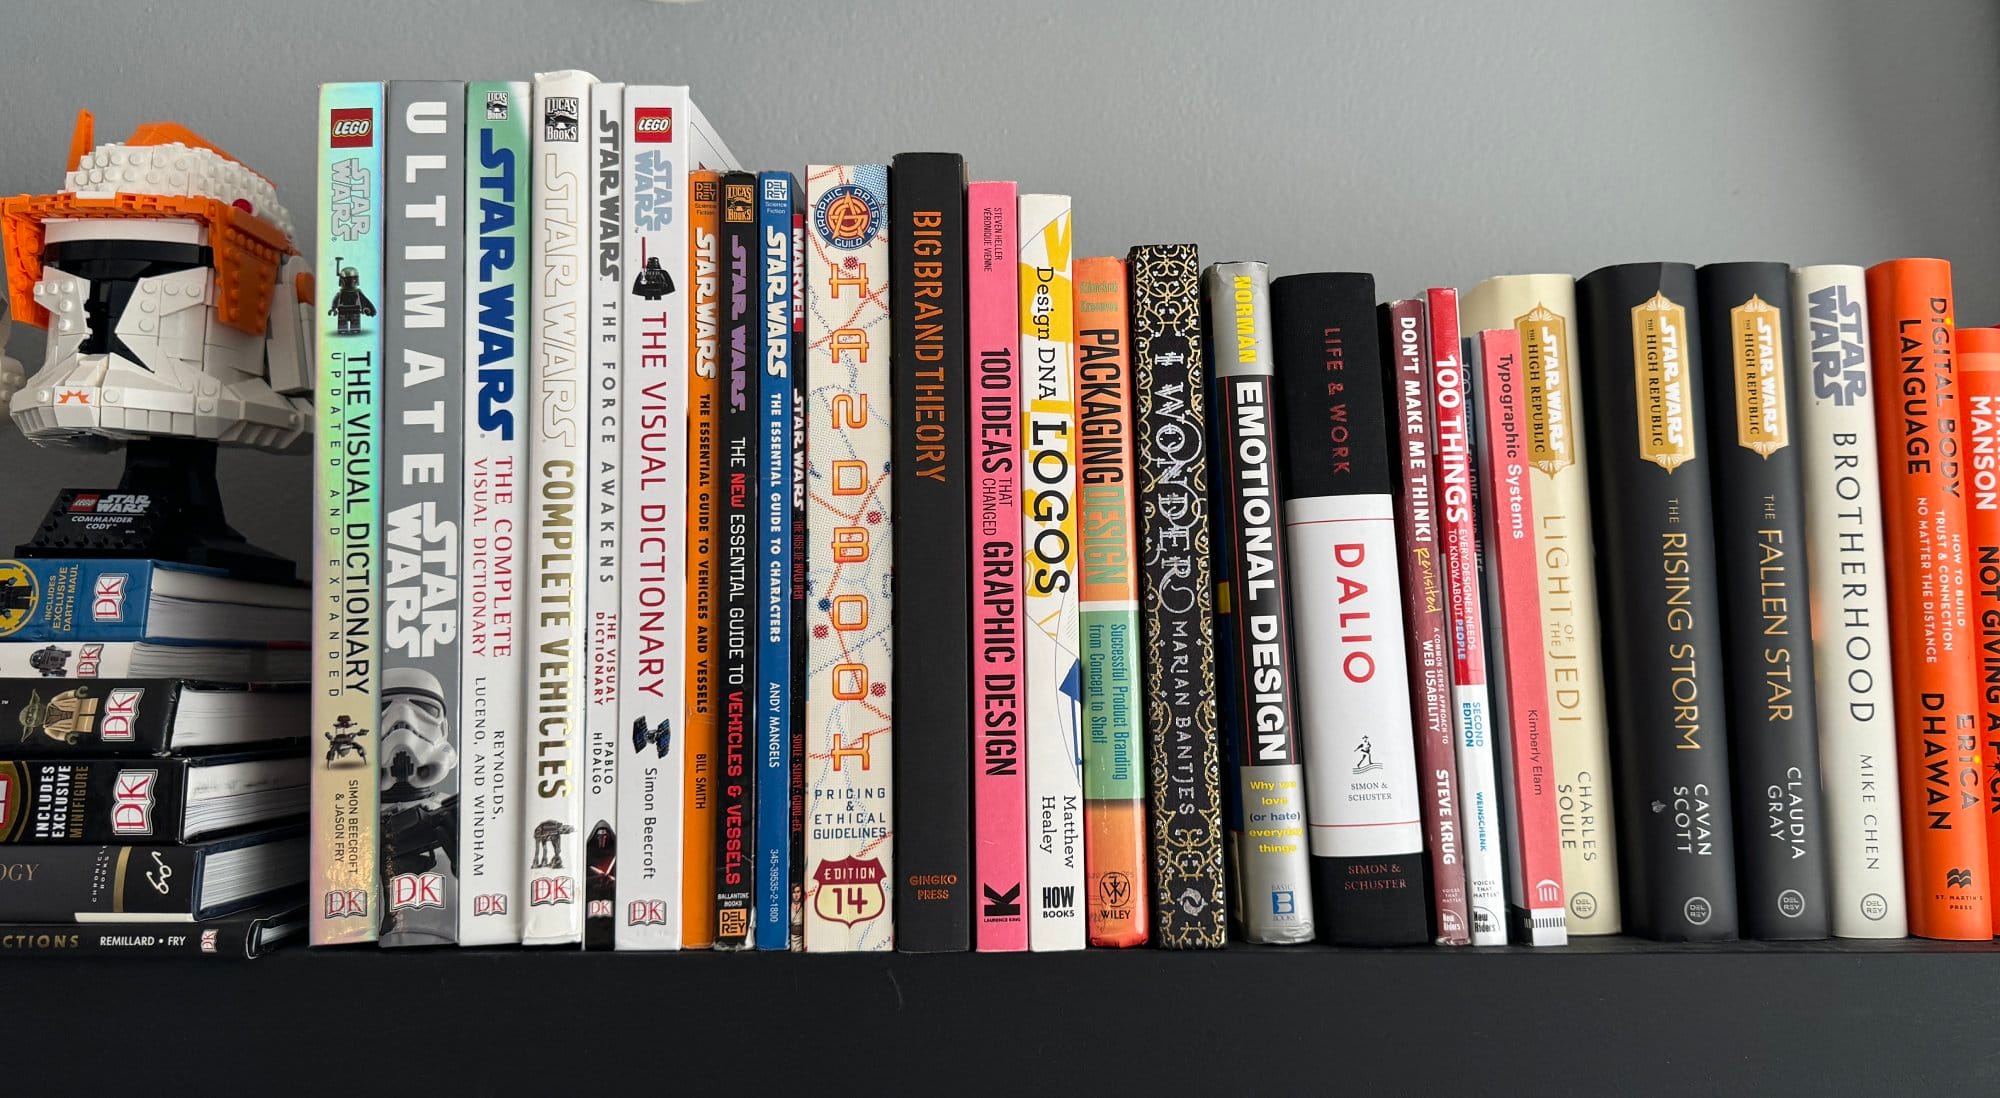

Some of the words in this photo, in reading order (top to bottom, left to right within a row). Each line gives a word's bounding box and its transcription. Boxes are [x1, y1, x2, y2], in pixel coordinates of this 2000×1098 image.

[332, 118, 371, 137] LEGO
[600, 109, 619, 194] STAR
[637, 117, 669, 133] LEGO
[480, 128, 516, 283] STAR
[913, 211, 942, 258] BIG
[600, 194, 619, 282] WARS
[694, 227, 717, 305] STAR
[766, 225, 787, 302] STAR
[402, 101, 447, 485] ULTIMATE
[732, 235, 748, 320] STAR
[1032, 266, 1055, 341] Design
[602, 302, 616, 343] THE
[641, 311, 667, 368] THE
[694, 304, 717, 381] WARS
[766, 301, 787, 379] WARS
[913, 261, 944, 361] BRAND
[1233, 275, 1257, 364] NORMAN
[477, 283, 515, 441] WARS
[730, 324, 748, 411] WARS
[980, 347, 1011, 390] 100
[1037, 347, 1057, 401] DNA
[1400, 317, 1420, 374] DON'T
[1528, 343, 1541, 380] HIGH
[1646, 334, 1659, 372] HIGH
[1929, 297, 1954, 408] DIGITAL
[330, 352, 342, 466] UPDATED
[347, 352, 371, 404] THE
[602, 362, 616, 443] FORCE
[699, 393, 711, 416] THE
[771, 393, 782, 416] THE
[1079, 329, 1124, 485] PACKAGING
[1404, 380, 1424, 435] MAKE
[1436, 353, 1460, 409] 100
[1499, 353, 1521, 460] Typographic
[1899, 319, 1931, 475] LANGUAGE
[640, 381, 667, 491] VISUAL
[915, 366, 946, 482] THEORY
[980, 396, 1013, 474] IDEAS
[1531, 382, 1546, 454] REPUBLIC
[1649, 376, 1664, 447] REPUBLIC
[347, 413, 371, 514] VISUAL
[495, 455, 513, 505] THE
[699, 421, 711, 488] ESSENTIAL
[730, 436, 745, 468] THE
[770, 421, 782, 488] ESSENTIAL
[1408, 439, 1426, 469] ME
[1440, 415, 1469, 524] THINGS
[1937, 419, 1960, 499] BODY
[330, 489, 341, 535] AND
[474, 457, 488, 517] VISUAL
[699, 492, 710, 533] GUIDE
[730, 472, 746, 509] NEW
[770, 492, 781, 533] GUIDE
[982, 478, 997, 536] CHANGED
[998, 476, 1013, 507] THAT
[1032, 420, 1071, 594] LOGOS
[1235, 381, 1276, 601] EMOTIONAL
[1412, 473, 1432, 542] THINK!
[1505, 463, 1524, 540] Systems
[1667, 498, 1680, 523] THE
[1763, 494, 1776, 520] THE
[1917, 497, 1929, 516] NO
[71, 515, 134, 523] COMMANDER
[542, 460, 576, 628] COMPLETE
[600, 461, 615, 584] AWAKENS
[698, 537, 709, 555] TO
[770, 537, 781, 555] TO
[1083, 487, 1128, 586] DESIGN
[1919, 520, 1932, 569] MATTER
[493, 518, 513, 658] COMPLETE
[729, 514, 745, 602] ESSENTIAL
[1543, 515, 1573, 612] LIGHT
[1661, 533, 1694, 632] RISING
[1758, 529, 1789, 635] FALLEN
[1833, 433, 1875, 722] BROTHERHOOD
[1921, 572, 1934, 598] THE
[44, 575, 57, 621] INCLUDES
[52, 566, 69, 629] EXCLUSIVE
[346, 522, 370, 695] DICTIONARY
[472, 537, 487, 658] DICTIONARY
[638, 504, 666, 698] DICTIONARY
[697, 560, 709, 620] VEHICLES
[769, 560, 781, 644] CHARACTERS
[982, 541, 1016, 663] GRAPHIC
[1333, 543, 1376, 684] DALIO
[328, 559, 340, 697] EXPANDED
[605, 613, 617, 640] THE
[697, 625, 708, 654] AND
[728, 607, 744, 660] GUIDE
[1423, 640, 1436, 669] WEB
[1923, 601, 1937, 664] DISTANCE
[595, 612, 605, 706] DICTIONARY
[605, 649, 617, 703] VISUAL
[696, 659, 708, 714] VESSELS
[728, 664, 743, 686] TO
[1250, 615, 1288, 760] DESIGN
[1549, 649, 1582, 721] JEDI
[1764, 648, 1793, 722] STAR
[475, 677, 486, 742] LUCENO,
[538, 639, 574, 799] VEHICLES
[769, 681, 781, 712] ANDY
[984, 674, 1017, 776] DESIGN
[1424, 670, 1440, 732] USABILITY
[1462, 702, 1475, 748] EDITION
[1473, 702, 1484, 747] SECOND
[1669, 643, 1702, 750] STORM
[592, 732, 603, 795] HIDALGO
[604, 741, 614, 785] PABLO
[727, 690, 743, 777] VEHICLES
[768, 715, 780, 769] MANGELS
[1528, 709, 1541, 765] Kimberly
[1921, 692, 1953, 830] DHAWAN
[1955, 714, 1981, 810] ERICA
[474, 753, 485, 782] AND
[493, 730, 505, 821] REYNOLDS,
[644, 767, 658, 811] Simon
[814, 788, 886, 801] PRICING
[1249, 780, 1275, 791] Why
[1348, 792, 1393, 801] SCHUSTER
[1436, 769, 1452, 817] STEVE
[1532, 766, 1543, 796] Elam
[1860, 754, 1876, 803] MIKE
[36, 765, 55, 838] INCLUDES
[52, 765, 72, 838] EXCLUSIVE
[69, 765, 89, 838] MINIFIGURE
[473, 784, 485, 878] WINDHAM
[814, 813, 886, 825] ETHICAL
[1040, 796, 1058, 855] Healey
[1063, 795, 1080, 868] Matthew
[1476, 791, 1488, 852] WEINSCHENK
[1557, 784, 1578, 849] SOULE
[1577, 770, 1598, 862] CHARLES
[1673, 786, 1692, 854] SCOTT
[1694, 783, 1712, 856] CAVAN
[1767, 784, 1785, 842] GRAY
[1787, 766, 1806, 860] CLAUDIA
[643, 817, 657, 880] Beecroft
[725, 804, 742, 885] VESSELS
[813, 827, 887, 840] GUIDELINES
[1440, 820, 1456, 865] KRUG
[1863, 814, 1880, 870] CHEN
[823, 867, 877, 881] EDITION
[832, 887, 869, 914] 14
[1042, 885, 1075, 909] HOW
[1343, 879, 1408, 891] SCHUSTER
[99, 935, 156, 947] REMILLARD
[167, 935, 187, 947] FRY
[1042, 909, 1075, 919] BOOKS
[1100, 910, 1131, 920] WILEY
